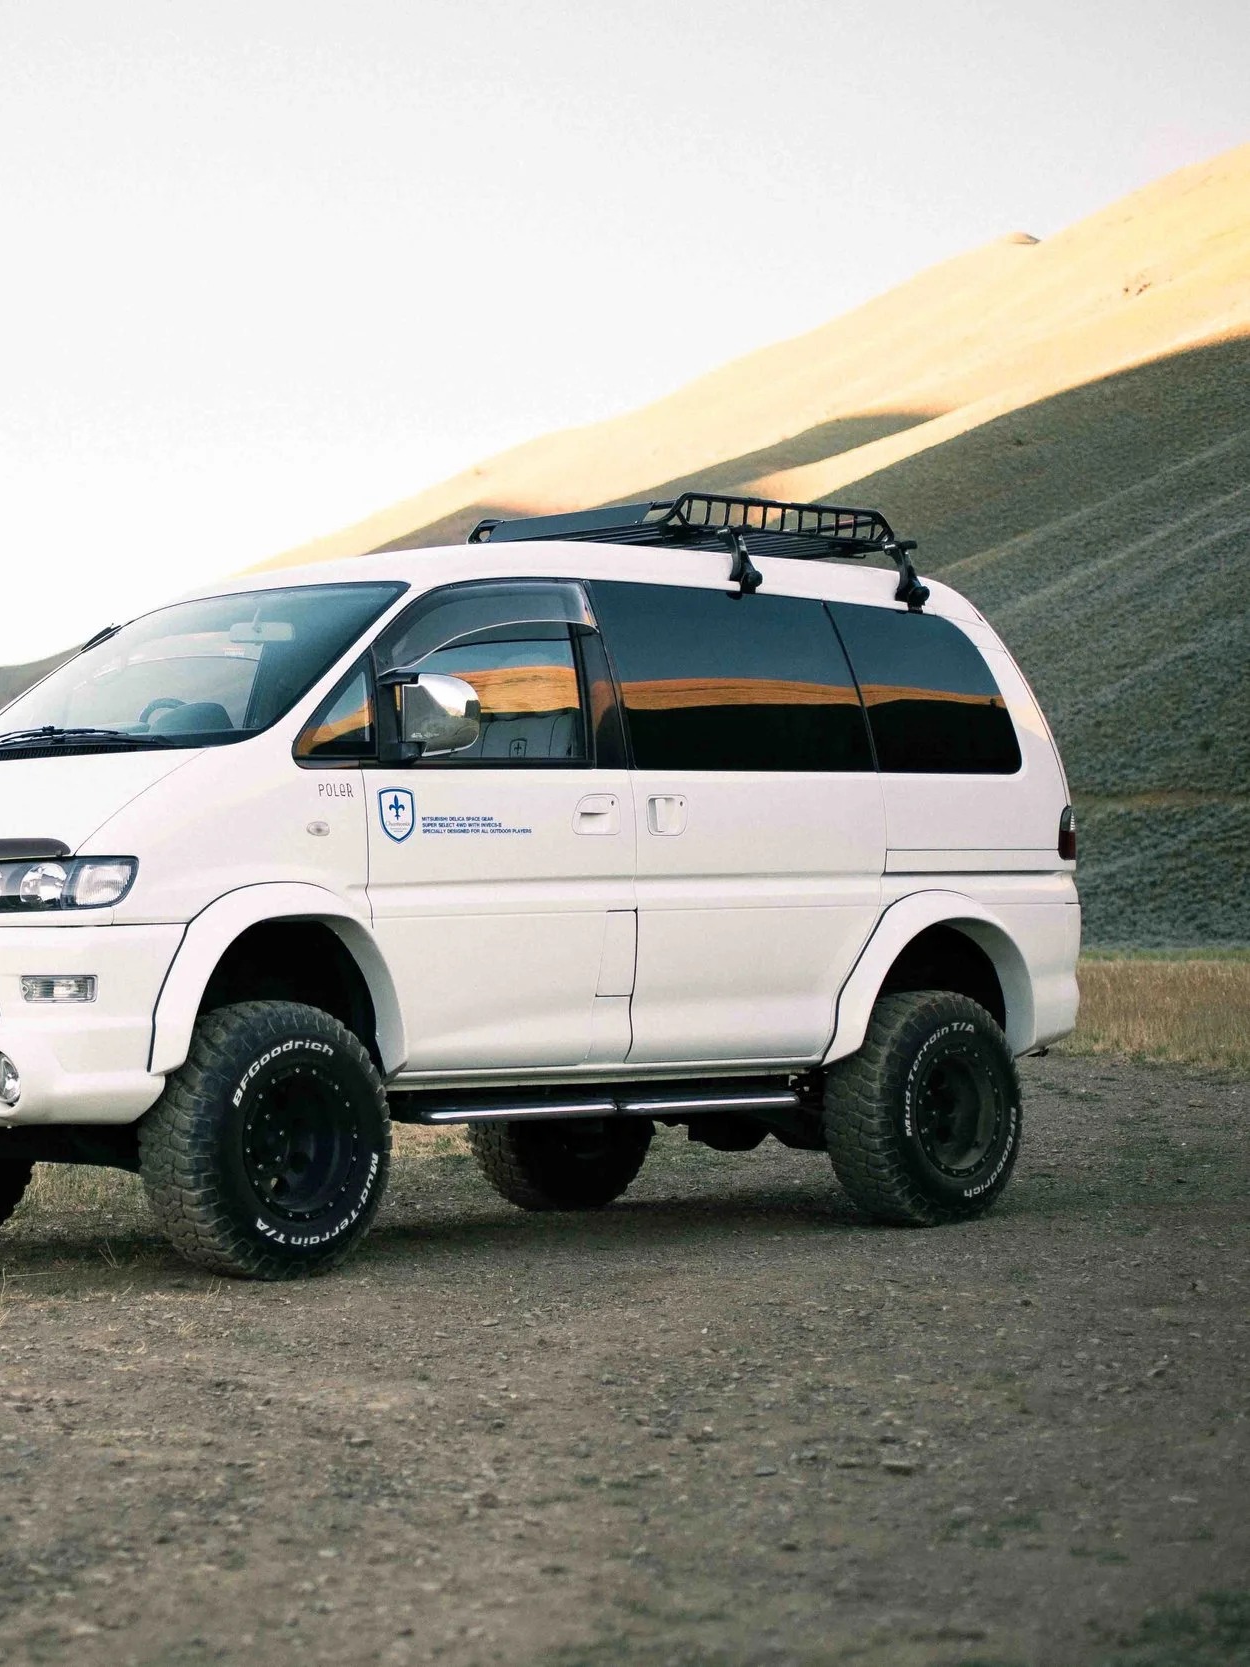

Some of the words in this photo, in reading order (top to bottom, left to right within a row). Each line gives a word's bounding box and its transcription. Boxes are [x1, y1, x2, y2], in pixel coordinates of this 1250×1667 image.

[232, 1039, 334, 1108] BFGoodrich
[904, 1025, 949, 1137] Mud-Terrain
[951, 1022, 975, 1034] T/A
[963, 1106, 1017, 1198] BFGoodrich
[256, 1217, 286, 1244] T/A
[290, 1152, 379, 1247] Mud-Terrain
